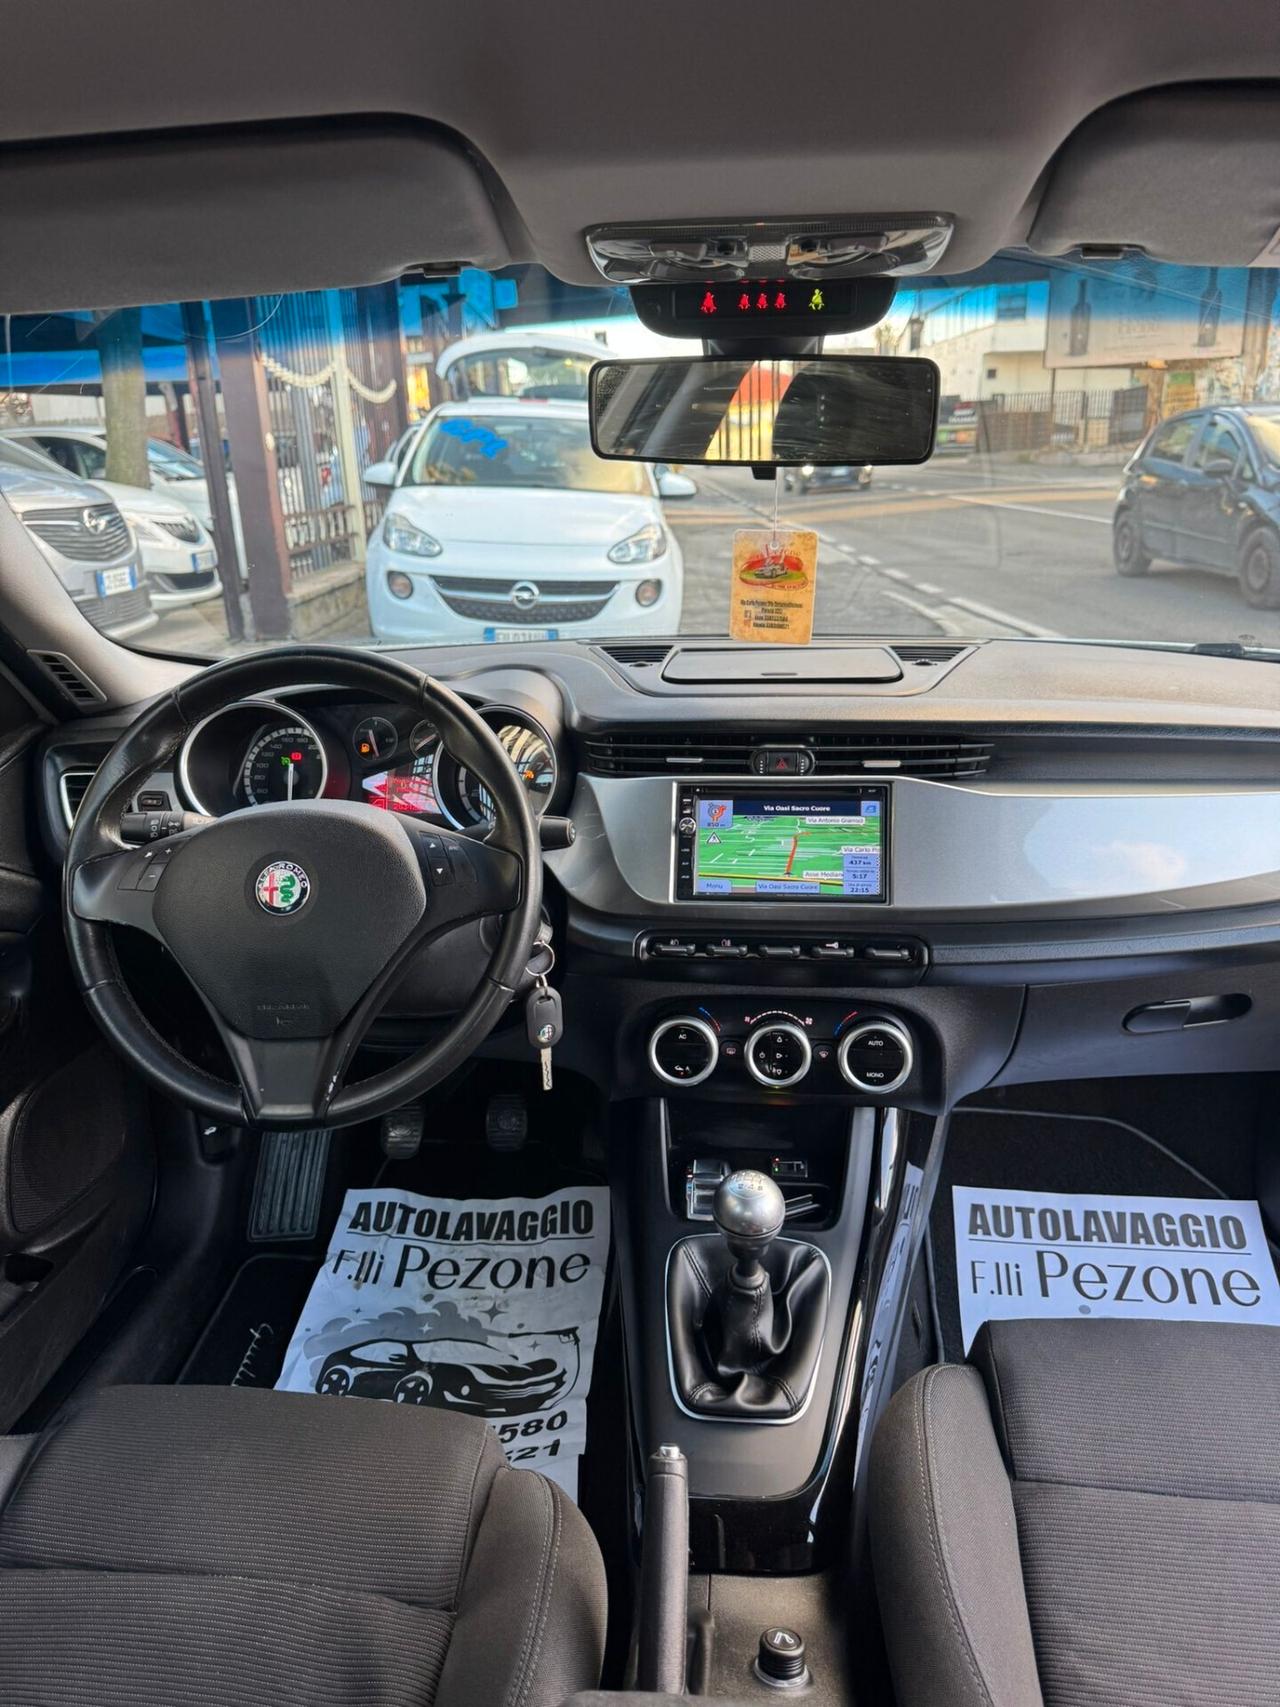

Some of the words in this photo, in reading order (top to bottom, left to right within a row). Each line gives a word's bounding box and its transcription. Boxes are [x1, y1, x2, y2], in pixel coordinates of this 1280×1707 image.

[791, 804, 810, 812] Sacro
[810, 804, 831, 812] Cuore
[279, 863, 308, 888] ROMEO
[758, 881, 768, 889] Via
[347, 1199, 595, 1242] AUTOLAVAGGIO
[967, 1202, 1249, 1251] AUTOLAVAGGIO
[331, 1249, 386, 1285] F.lli
[392, 1244, 591, 1290] Pezone
[969, 1259, 1024, 1297] F.lli
[1035, 1249, 1263, 1308] Pezone
[491, 1409, 569, 1444] 580
